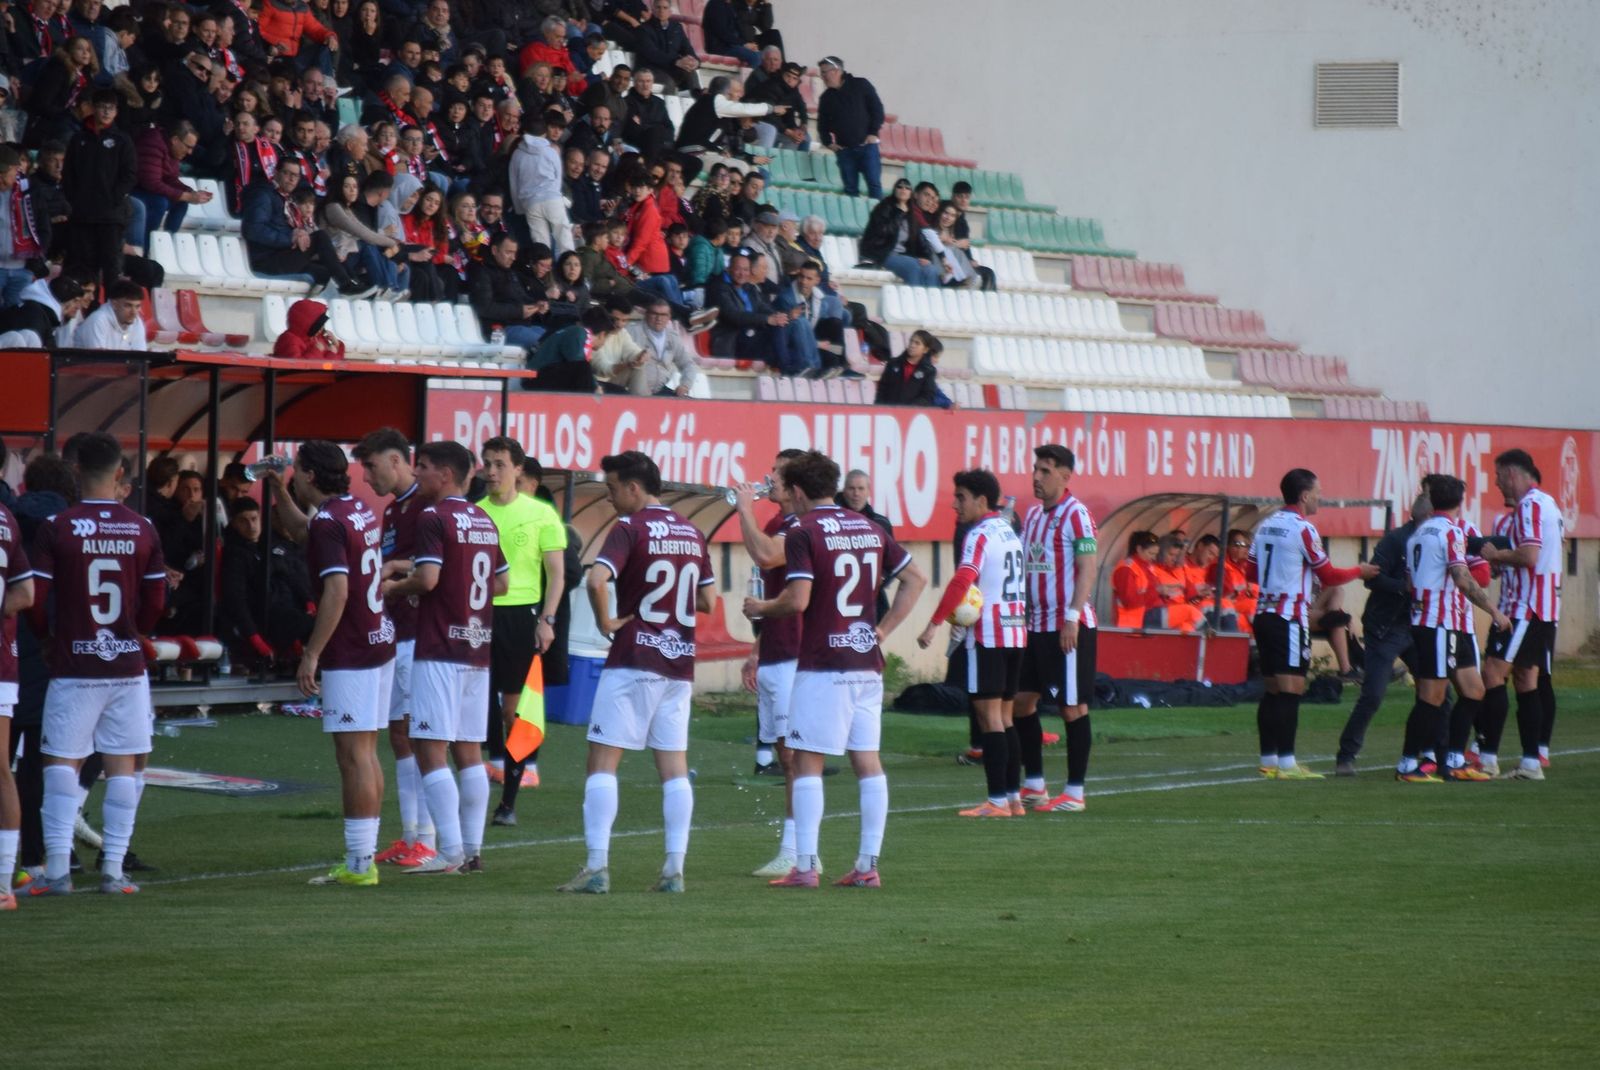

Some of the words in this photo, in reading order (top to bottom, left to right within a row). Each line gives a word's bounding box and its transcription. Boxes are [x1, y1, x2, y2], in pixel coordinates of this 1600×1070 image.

[1147, 429, 1173, 476] DE
[1186, 431, 1255, 478] STAND
[82, 539, 136, 555] ALVARO
[648, 540, 691, 556] ALBERTO
[825, 535, 851, 551] DIEGO
[88, 559, 122, 625] 5
[470, 552, 491, 610] 8
[639, 560, 700, 627] 20
[835, 552, 878, 617] 21
[636, 631, 696, 657] PESCAMA
